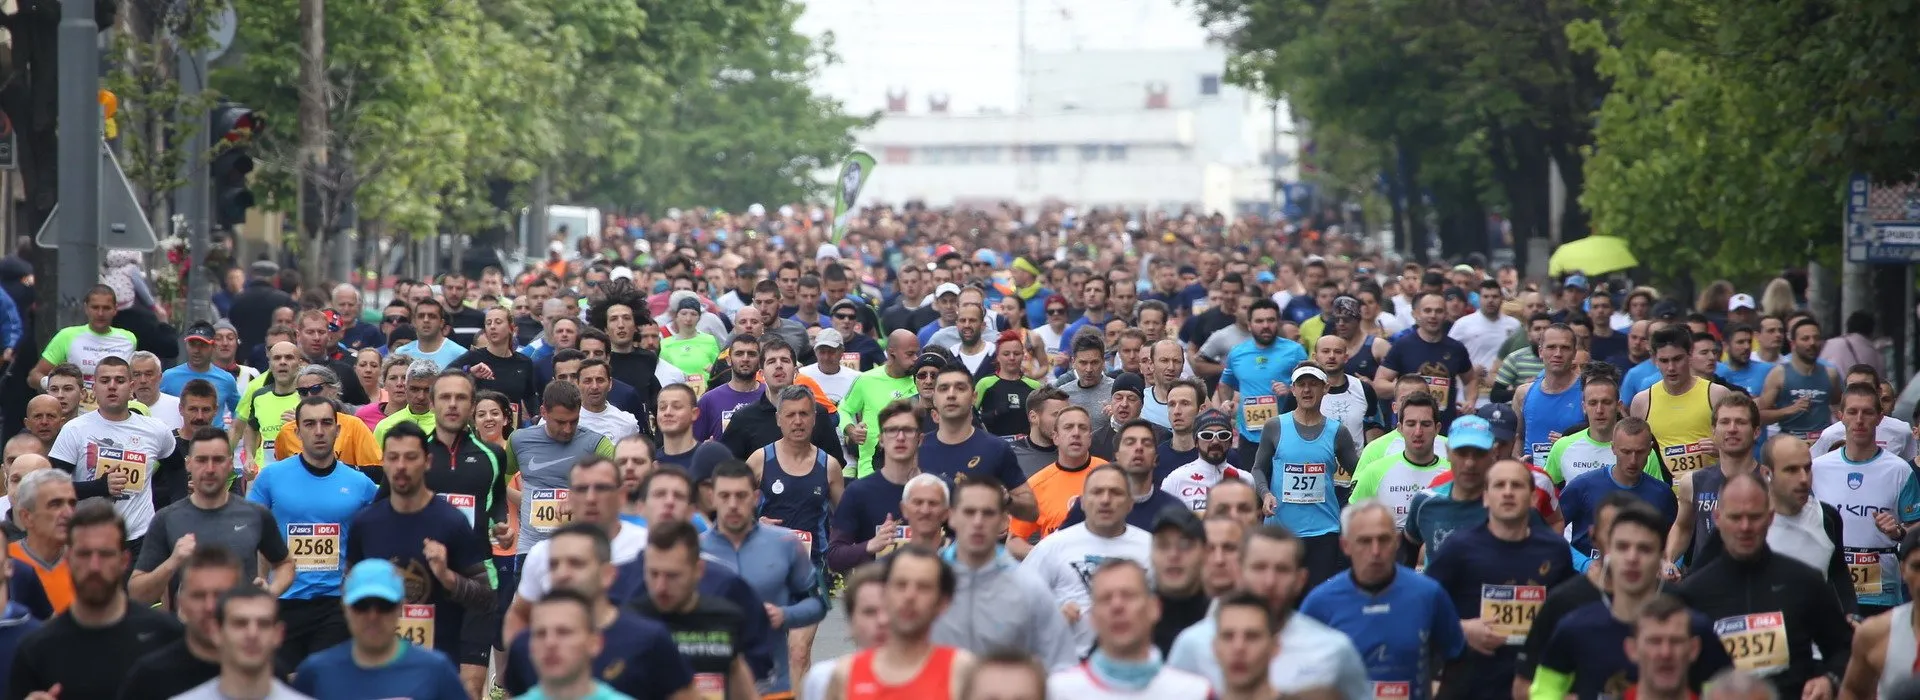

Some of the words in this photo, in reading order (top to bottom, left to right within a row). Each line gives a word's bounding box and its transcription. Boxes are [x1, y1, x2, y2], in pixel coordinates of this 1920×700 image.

[1670, 454, 1704, 472] 2831
[1292, 476, 1317, 491] 257
[294, 538, 334, 556] 2568
[1490, 604, 1537, 626] 2814
[1724, 631, 1776, 658] 2357
